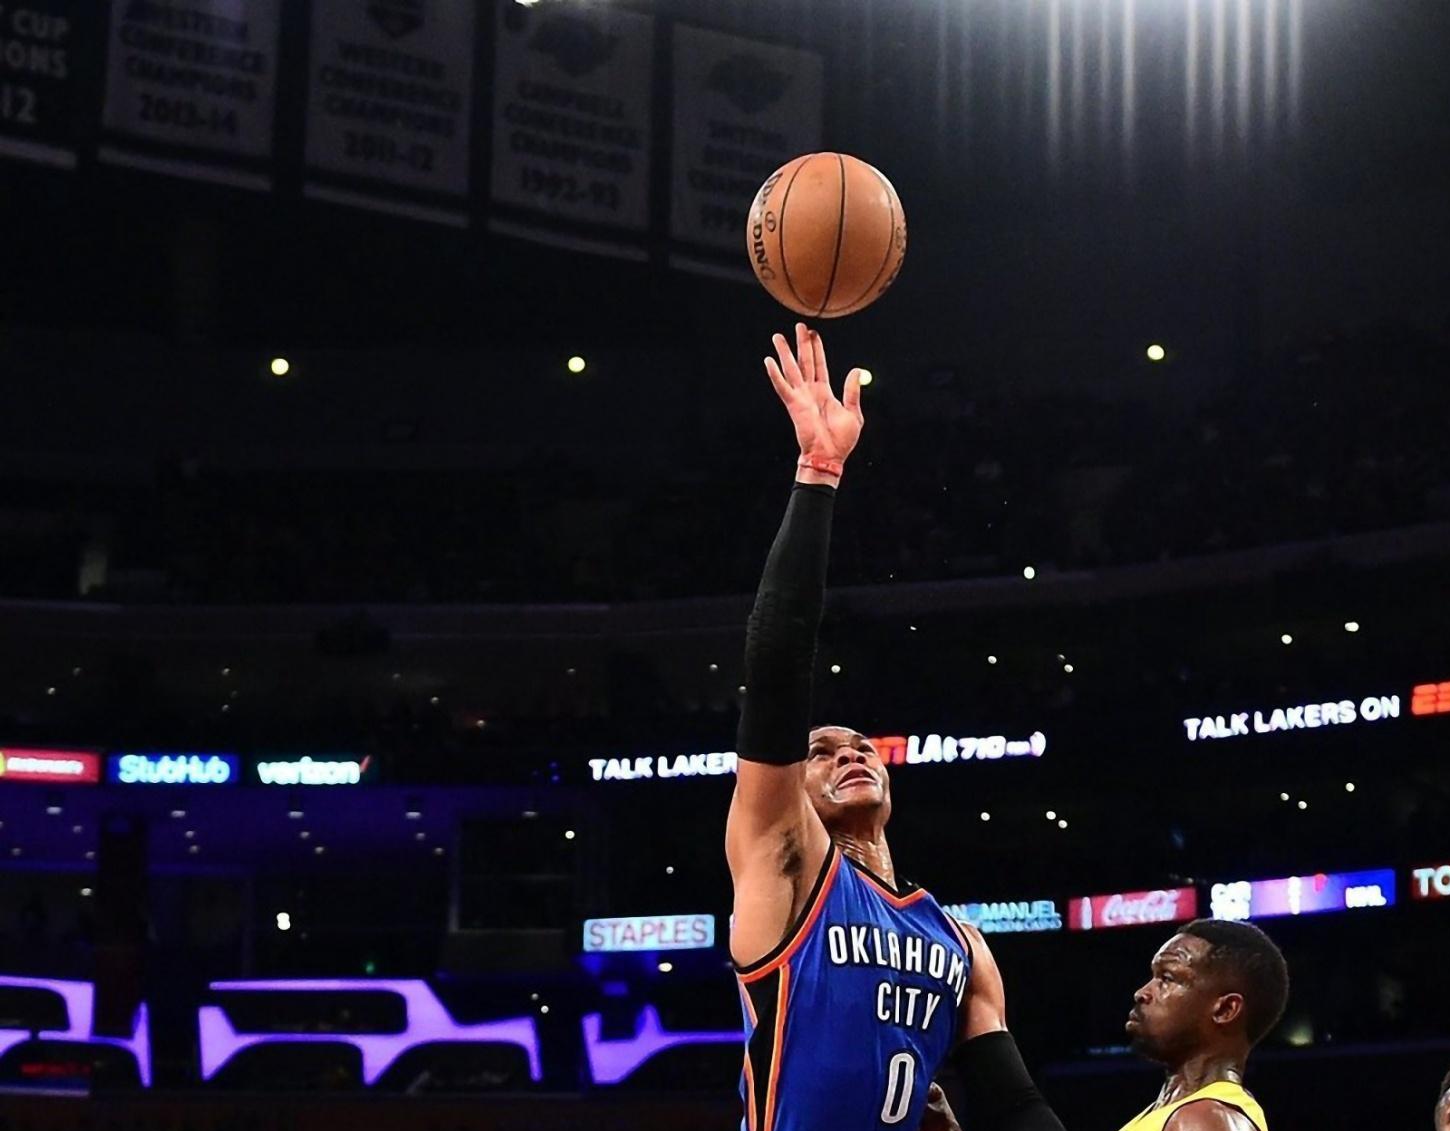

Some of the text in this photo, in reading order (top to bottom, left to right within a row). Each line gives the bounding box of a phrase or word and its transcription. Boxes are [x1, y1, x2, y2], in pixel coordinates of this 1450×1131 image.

[1183, 713, 1249, 740] TALK
[1253, 700, 1356, 733] LAKERS
[1360, 694, 1400, 721] ON
[589, 756, 654, 780] TALK
[658, 752, 738, 777] LAKER
[588, 917, 709, 949] STAPLES
[877, 982, 940, 1030] CITY
[881, 1053, 915, 1124] 0
